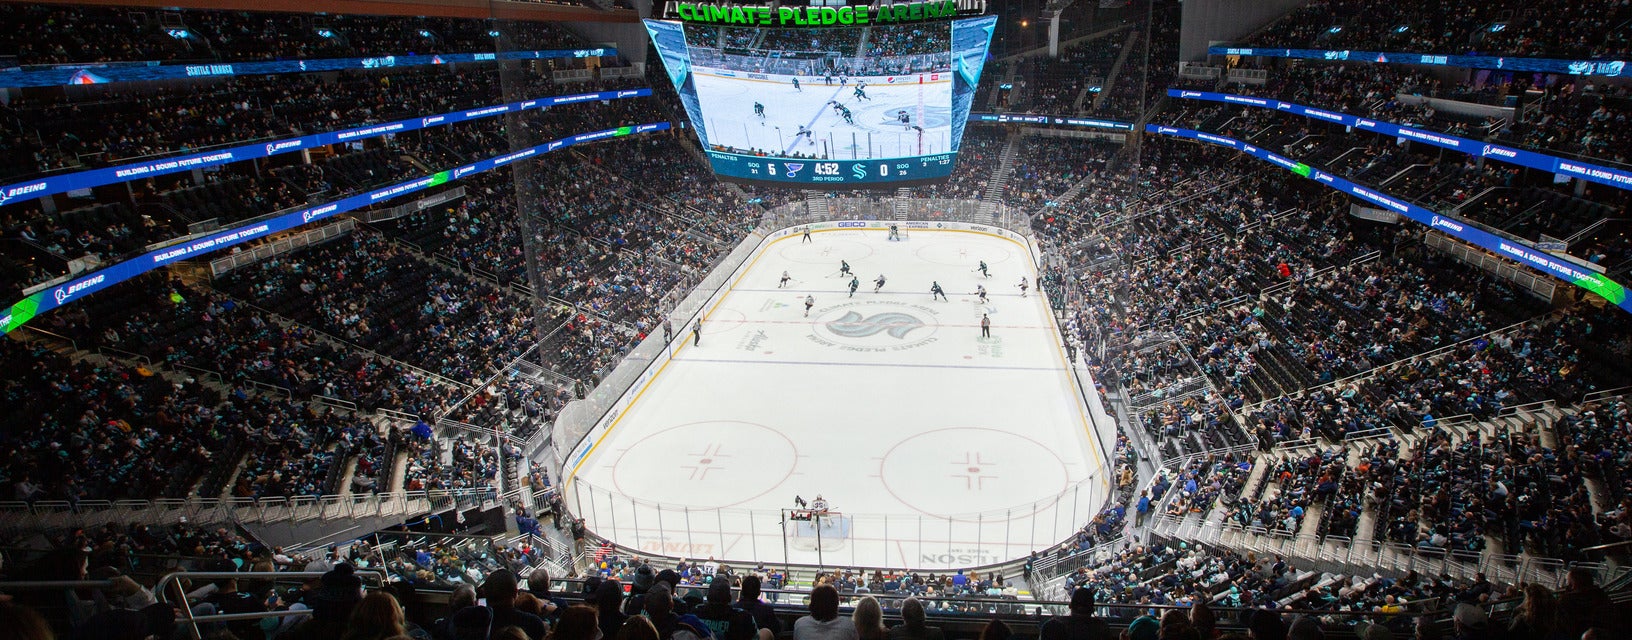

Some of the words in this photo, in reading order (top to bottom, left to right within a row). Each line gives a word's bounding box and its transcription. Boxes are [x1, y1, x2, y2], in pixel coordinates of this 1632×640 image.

[678, 4, 771, 25] CLIMATE
[779, 5, 869, 25] PLEDGE
[875, 0, 957, 21] ARENA
[116, 165, 150, 178] BUILDING
[156, 161, 178, 171] SOUND
[178, 157, 203, 167] FUTURE
[203, 152, 233, 163] TOGETHER
[711, 153, 738, 161] PENALTIES
[920, 155, 950, 163] PENALTIES
[767, 163, 776, 175] 5
[814, 163, 840, 175] 4:52
[880, 164, 888, 176] 0
[1559, 162, 1586, 174] BUILDING
[1586, 168, 1591, 176] A
[1591, 169, 1612, 180] SOUND
[9, 182, 47, 197] BOEING
[154, 247, 186, 263] BUILDING
[193, 240, 215, 252] SOUND
[215, 234, 239, 246] FUTURE
[239, 224, 268, 238] TOGETHER
[1500, 242, 1524, 258] BUILDING
[1529, 254, 1548, 267] SOUND
[1548, 260, 1572, 275] FUTURE
[68, 274, 105, 295] BOEING
